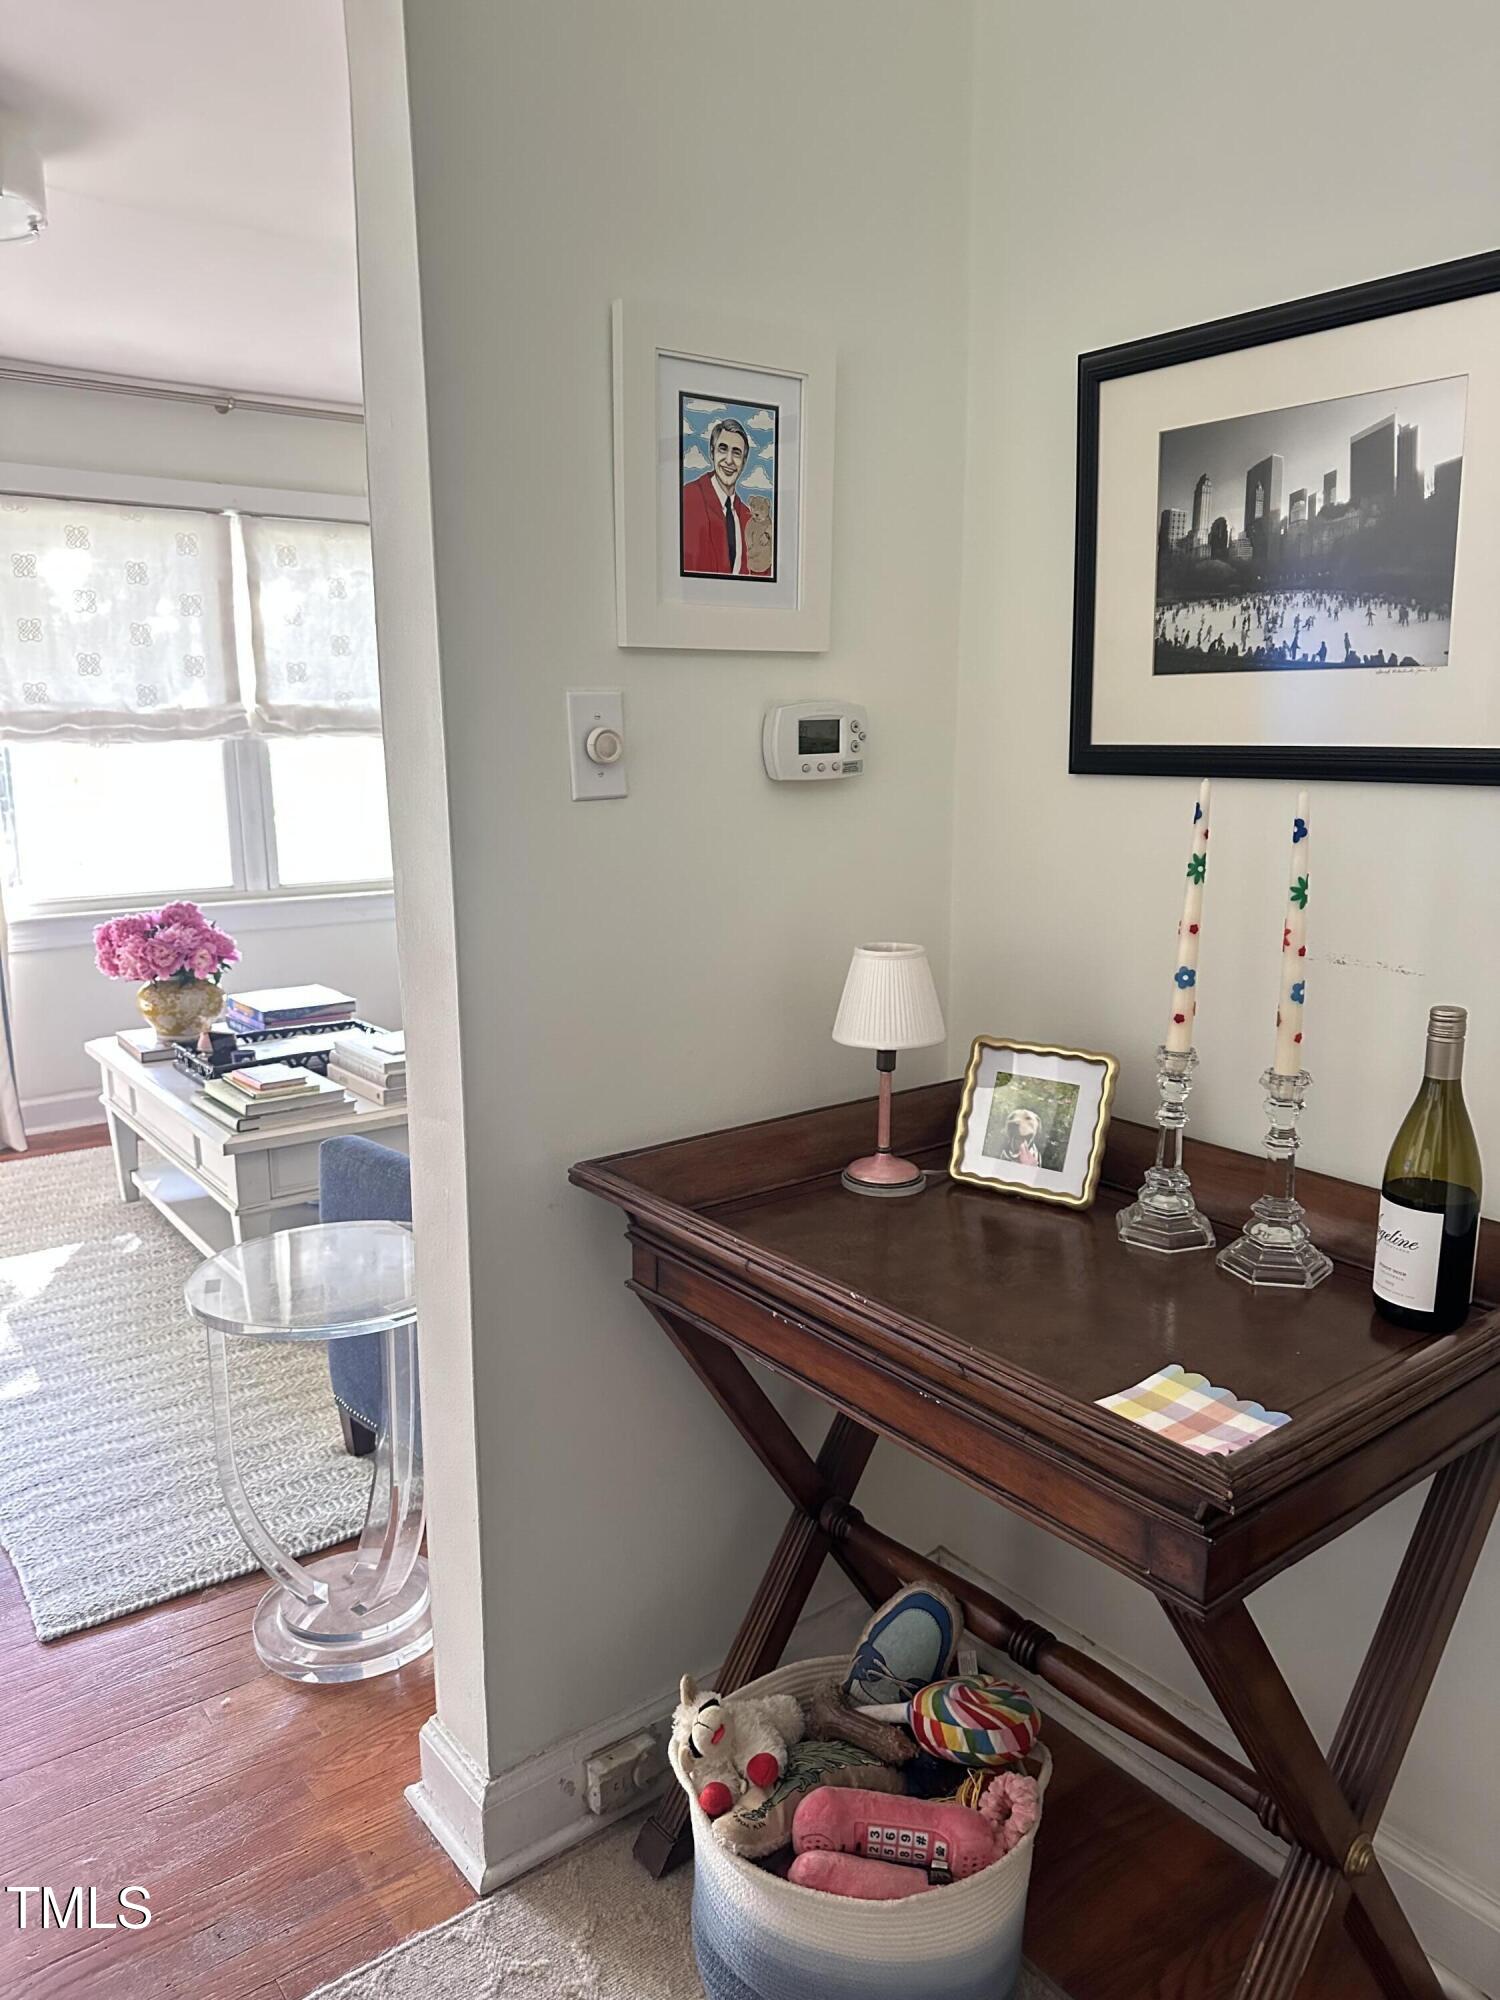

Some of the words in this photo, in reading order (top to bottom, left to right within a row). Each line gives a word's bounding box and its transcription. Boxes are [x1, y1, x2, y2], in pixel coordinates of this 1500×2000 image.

[885, 1832, 895, 1840] 6
[901, 1834, 911, 1842] 9
[916, 1836, 926, 1845] #
